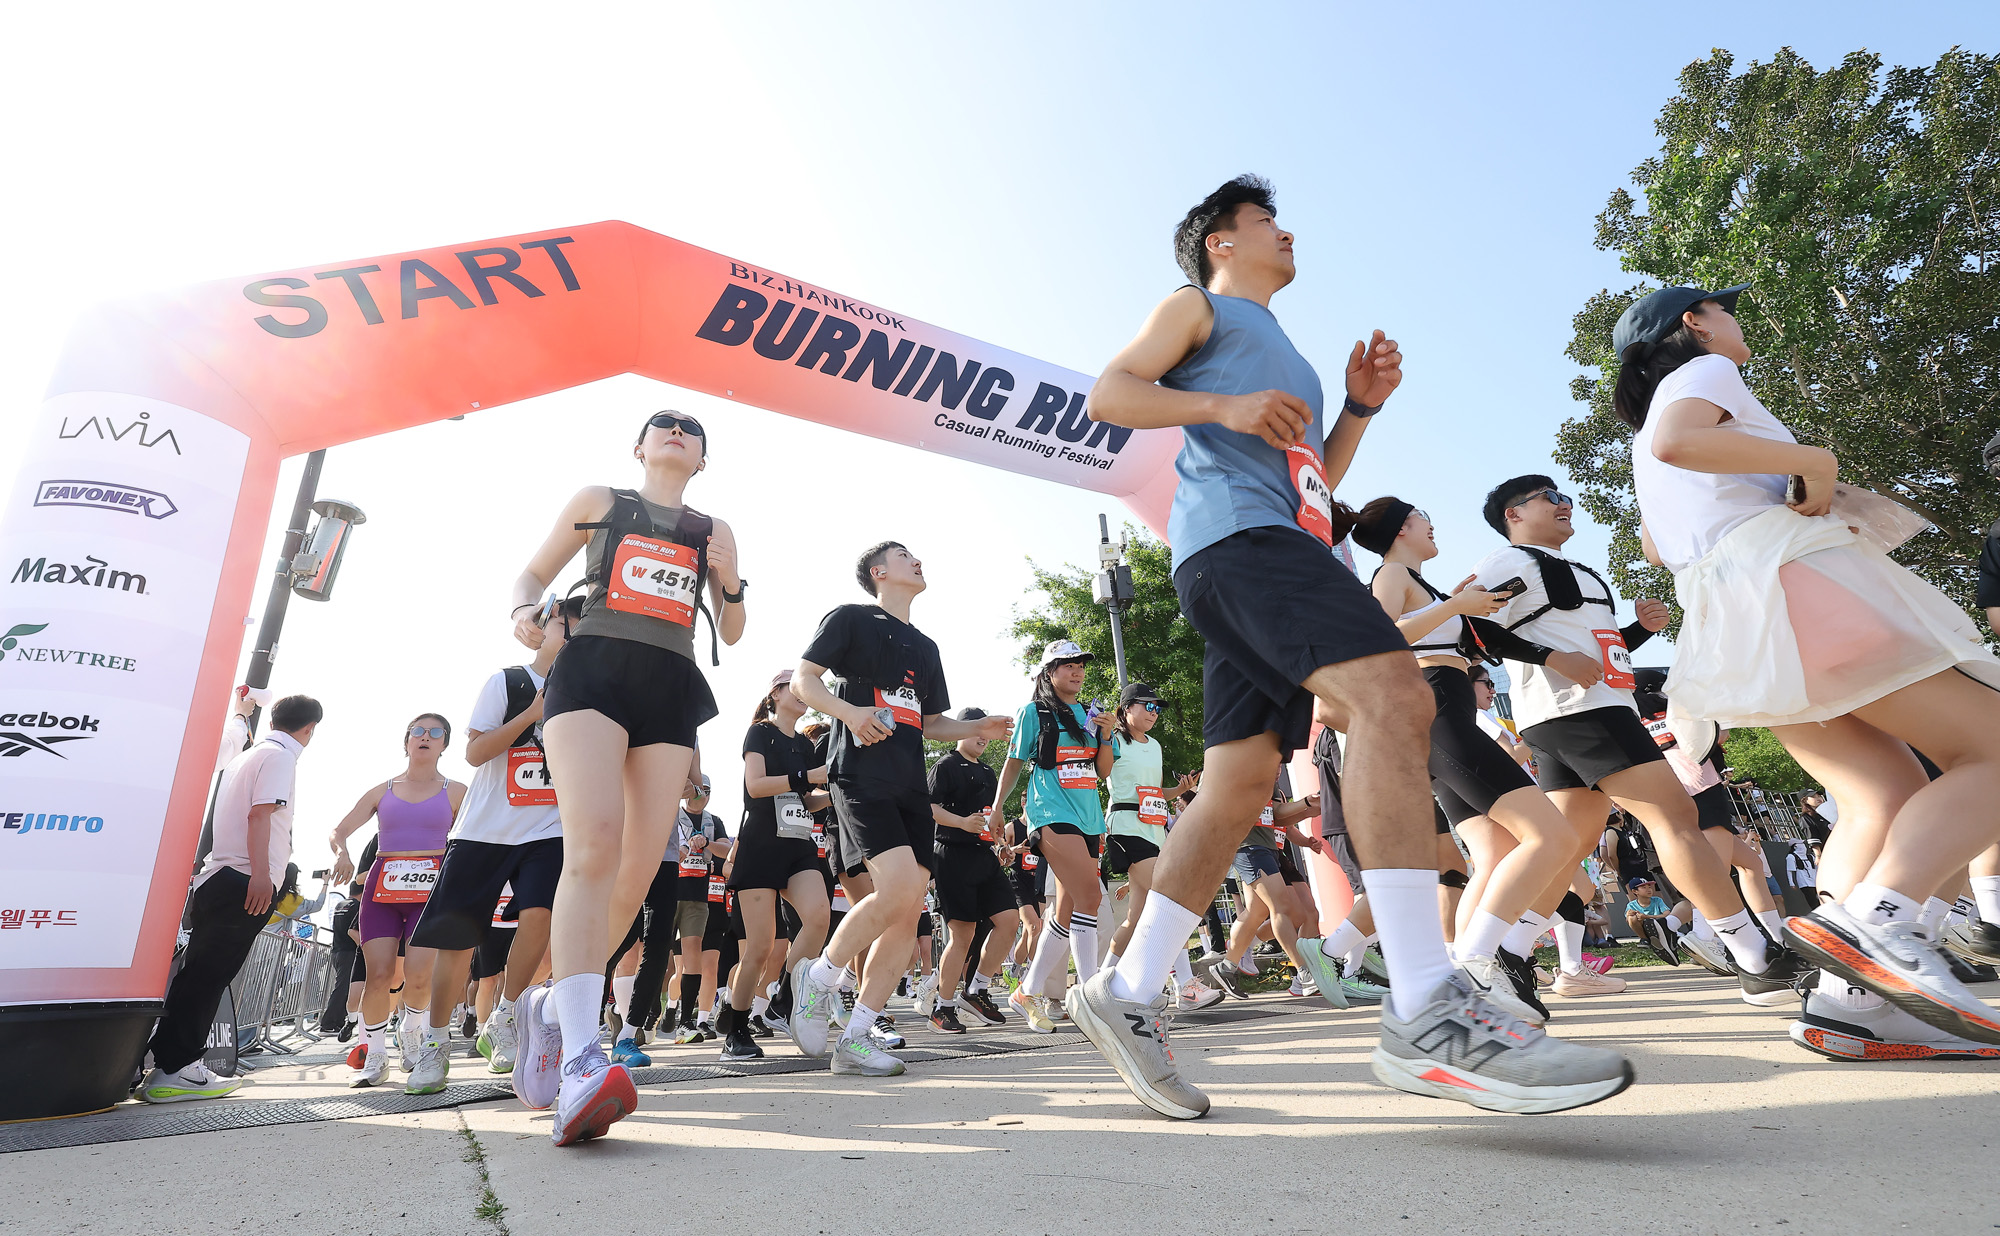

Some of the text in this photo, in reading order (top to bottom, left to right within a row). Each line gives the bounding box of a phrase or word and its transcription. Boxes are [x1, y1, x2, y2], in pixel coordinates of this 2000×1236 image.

[243, 236, 581, 338] START
[695, 283, 1015, 422] BURNING
[934, 413, 1114, 471] Casual Running Festival
[1306, 476, 1318, 492] M
[43, 485, 156, 516] FAVONEX
[624, 538, 660, 550] BURNING
[660, 546, 678, 556] RUN
[11, 555, 146, 594] Maxim
[632, 566, 696, 594] W 4512
[16, 647, 137, 672] NEWTREE
[1614, 652, 1620, 661] M
[522, 770, 533, 778] M
[400, 873, 436, 883] 4305
[216, 1022, 232, 1048] LINE
